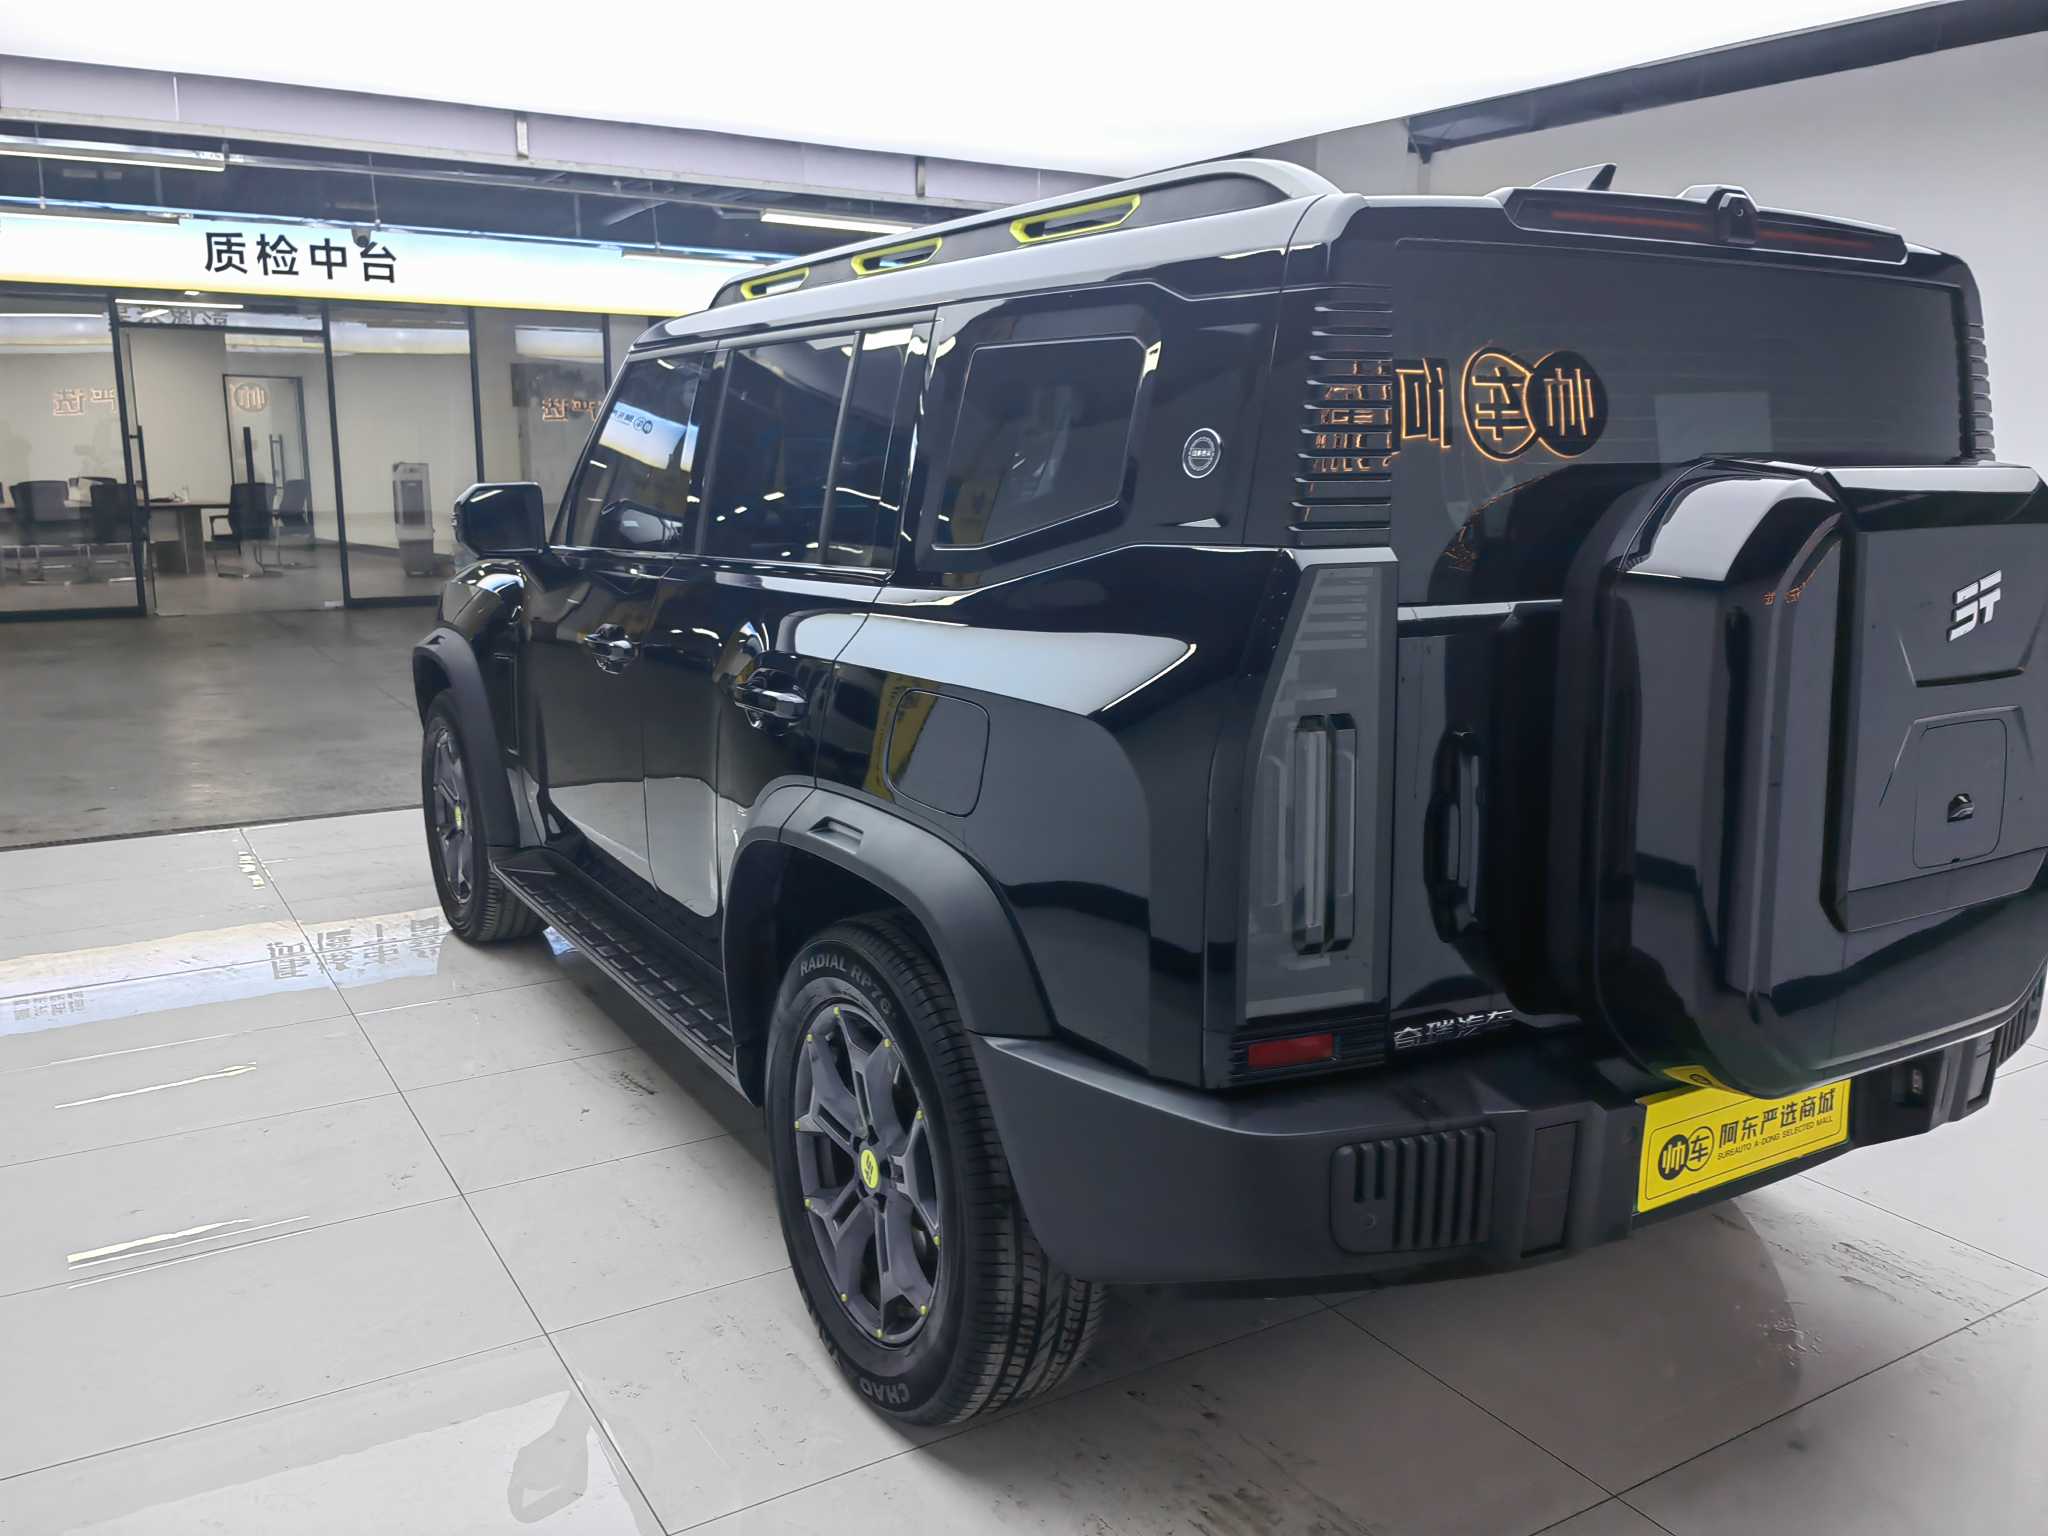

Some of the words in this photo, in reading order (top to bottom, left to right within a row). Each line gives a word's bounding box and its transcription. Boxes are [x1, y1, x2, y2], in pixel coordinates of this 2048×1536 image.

[204, 231, 397, 284] 质检中台
[800, 953, 848, 977] RADIAL
[1717, 1143, 1752, 1161] SUREAUTO
[1782, 1121, 1815, 1139] SELECTED
[1817, 1115, 1834, 1128] MALL
[1719, 1087, 1837, 1149] 阿东严选商城
[859, 1376, 911, 1404] CHAO
